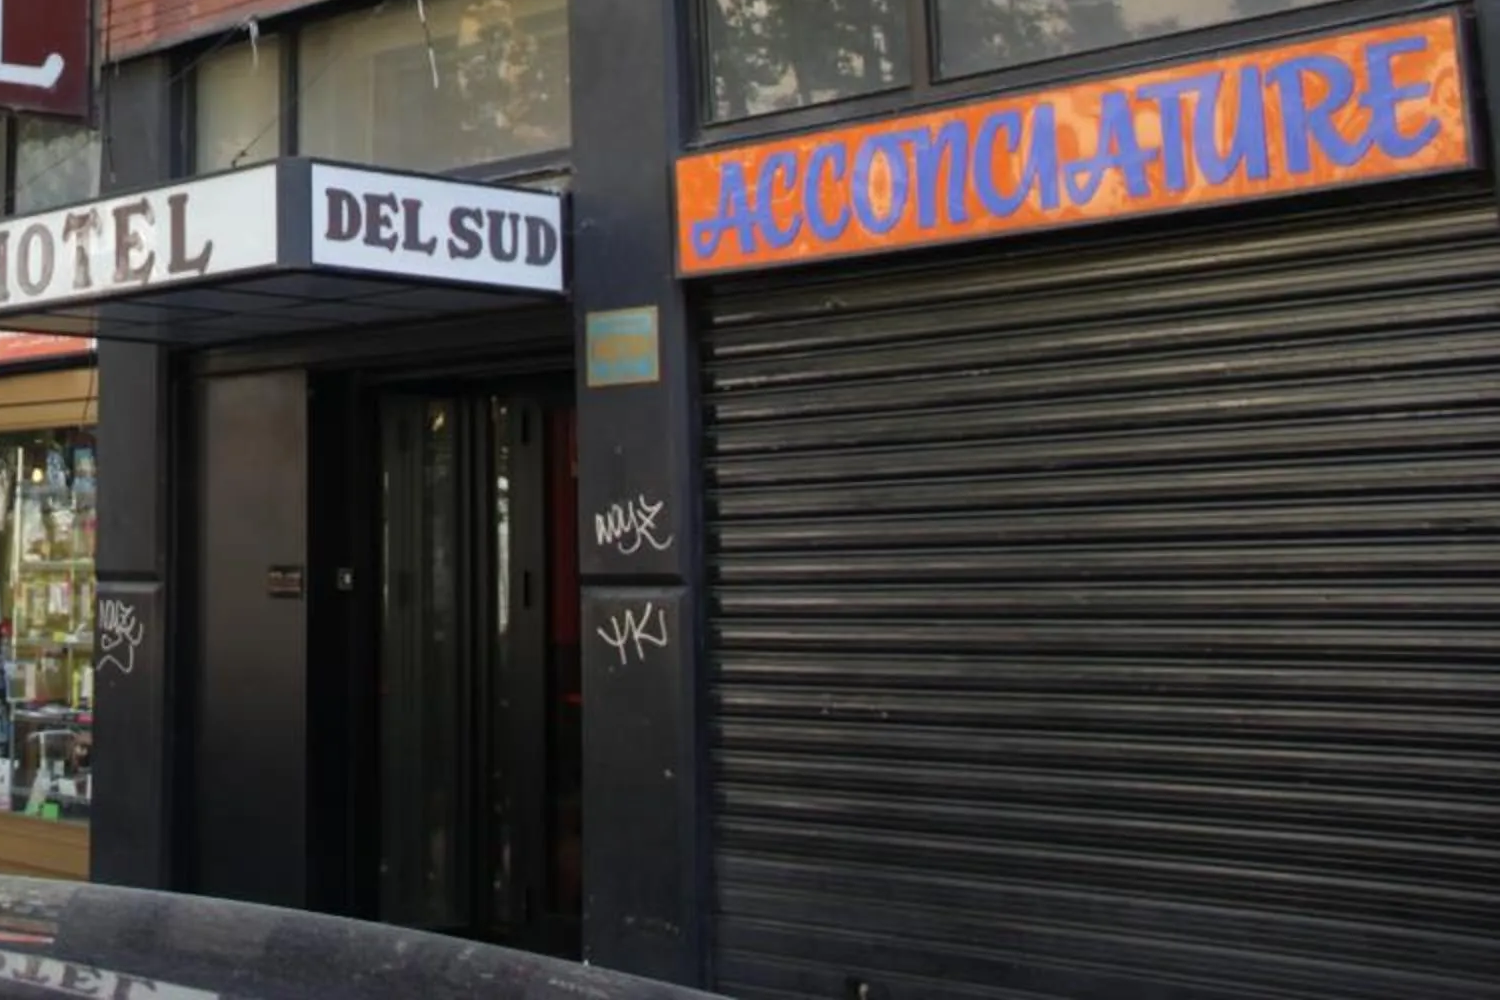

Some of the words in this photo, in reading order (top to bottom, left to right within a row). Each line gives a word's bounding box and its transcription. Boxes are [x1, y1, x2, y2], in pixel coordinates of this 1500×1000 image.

[690, 34, 1443, 260] ACCONCIATURE
[324, 187, 438, 258] DEL
[447, 206, 560, 267] SUD
